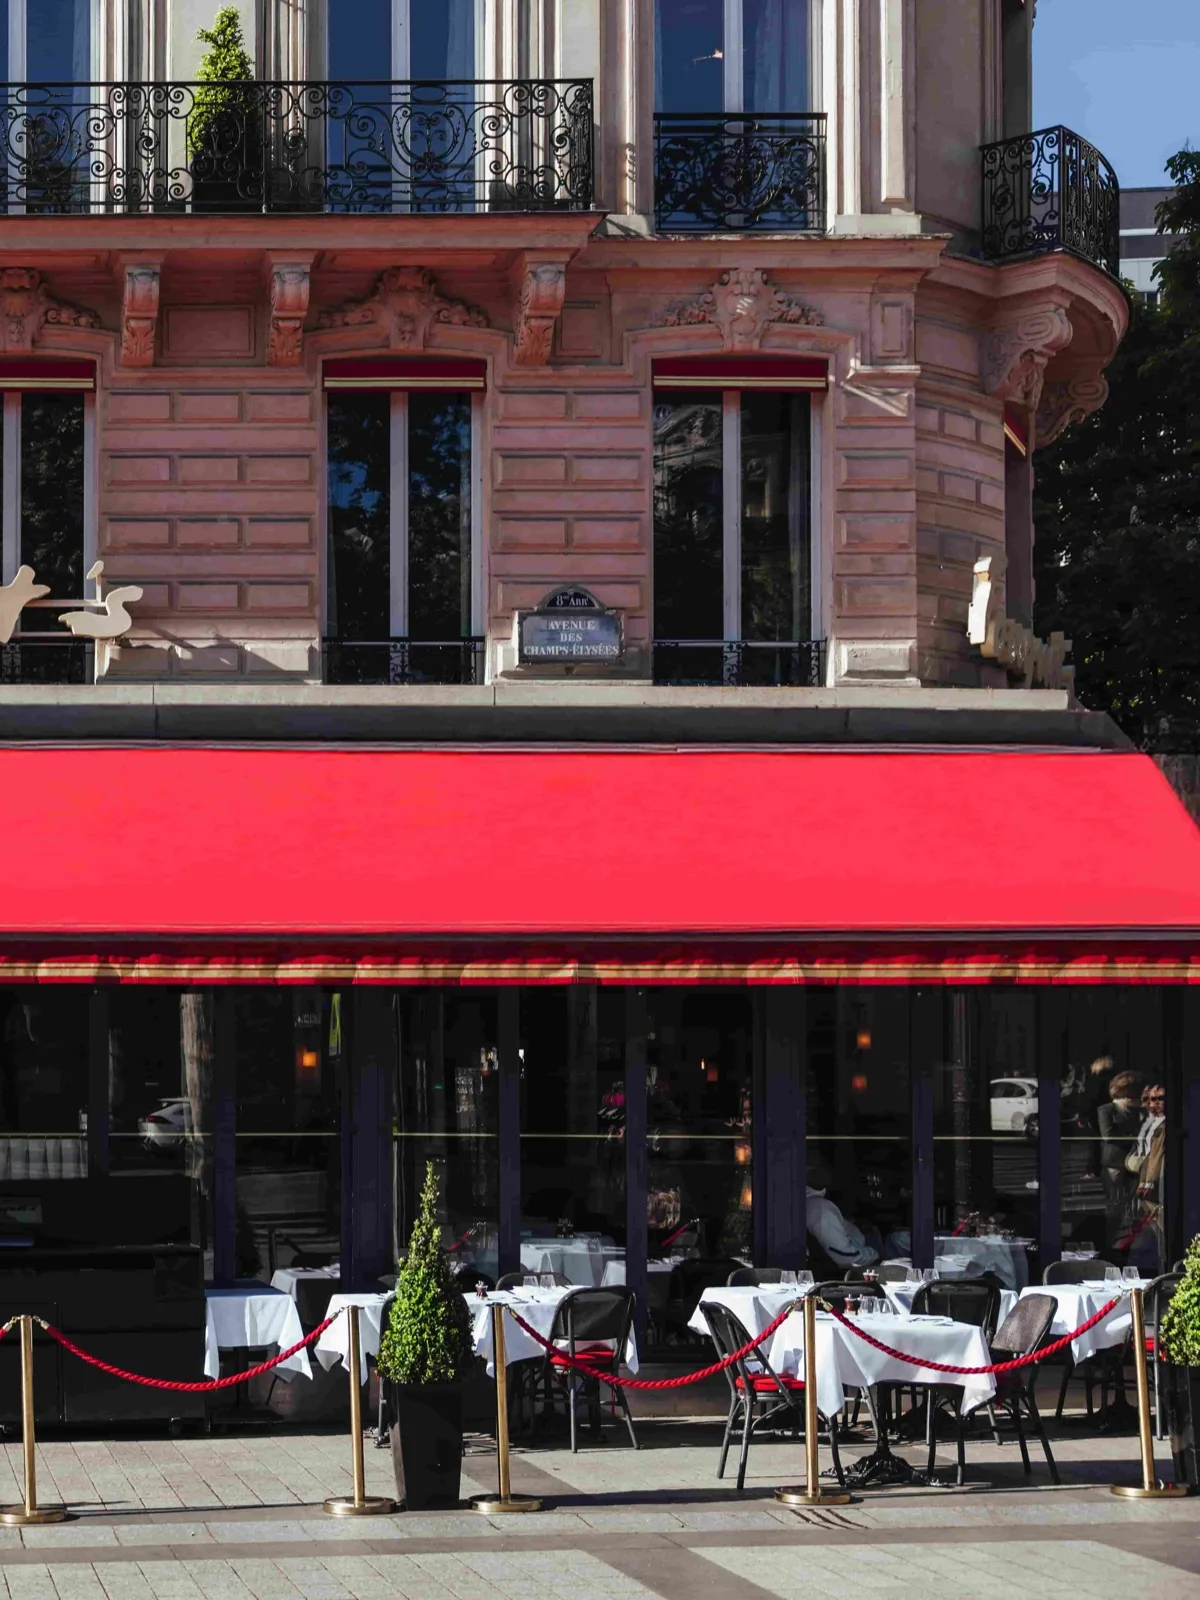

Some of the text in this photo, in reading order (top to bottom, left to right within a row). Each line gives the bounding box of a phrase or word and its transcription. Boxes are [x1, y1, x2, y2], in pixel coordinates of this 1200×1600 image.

[548, 620, 596, 630] AVENUE
[560, 632, 583, 642] DES
[523, 643, 620, 656] CHAMPS-ÉLYSÉES
